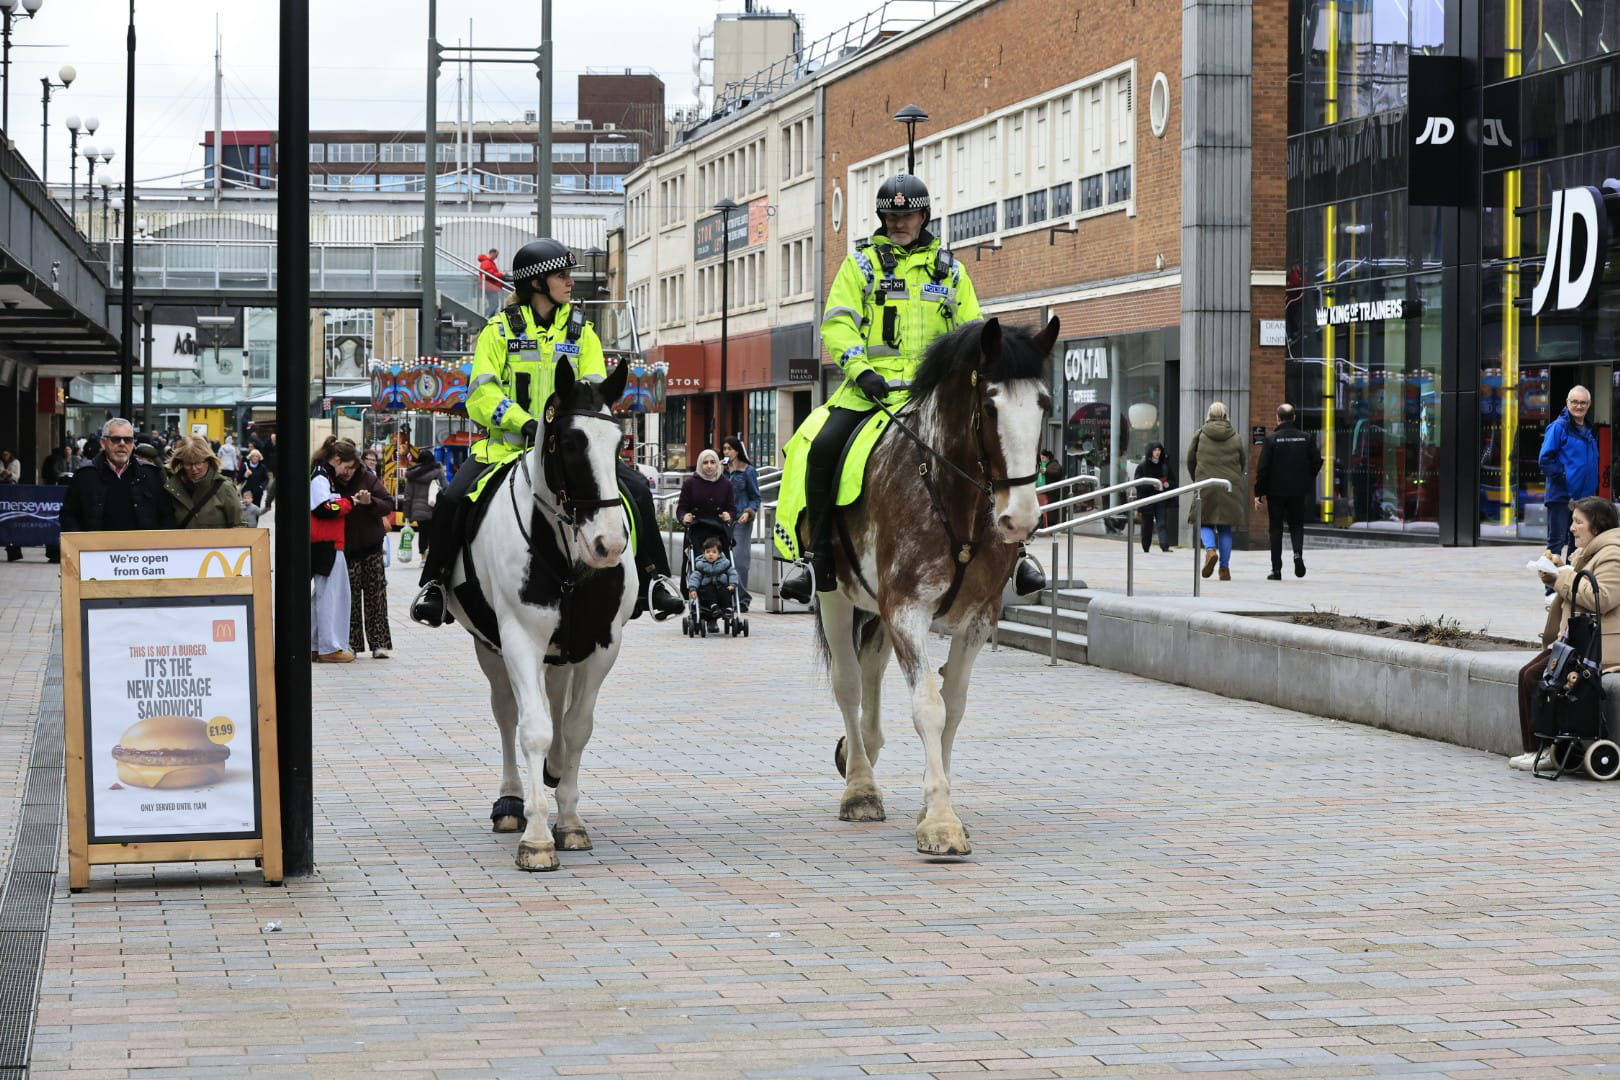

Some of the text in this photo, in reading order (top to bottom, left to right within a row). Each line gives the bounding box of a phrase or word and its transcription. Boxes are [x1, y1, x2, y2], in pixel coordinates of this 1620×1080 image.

[1415, 116, 1455, 145] JD
[1531, 186, 1599, 317] JD
[1329, 299, 1403, 324] KING OF TRAINERS
[508, 341, 519, 350] XH
[556, 344, 579, 354] POLICE
[0, 501, 63, 515] merseywa
[109, 554, 169, 565] We're open
[114, 567, 165, 576] from 6am
[129, 644, 207, 657] THIS IS NOT A BURGER
[145, 658, 192, 677] IT'S THE
[127, 678, 212, 699] NEW SAUSAGE
[138, 699, 203, 719] SANDWICH
[209, 724, 233, 737] £1.99
[140, 803, 154, 812] ONLY
[155, 803, 176, 811] SERVED
[176, 802, 192, 811] UNTIL
